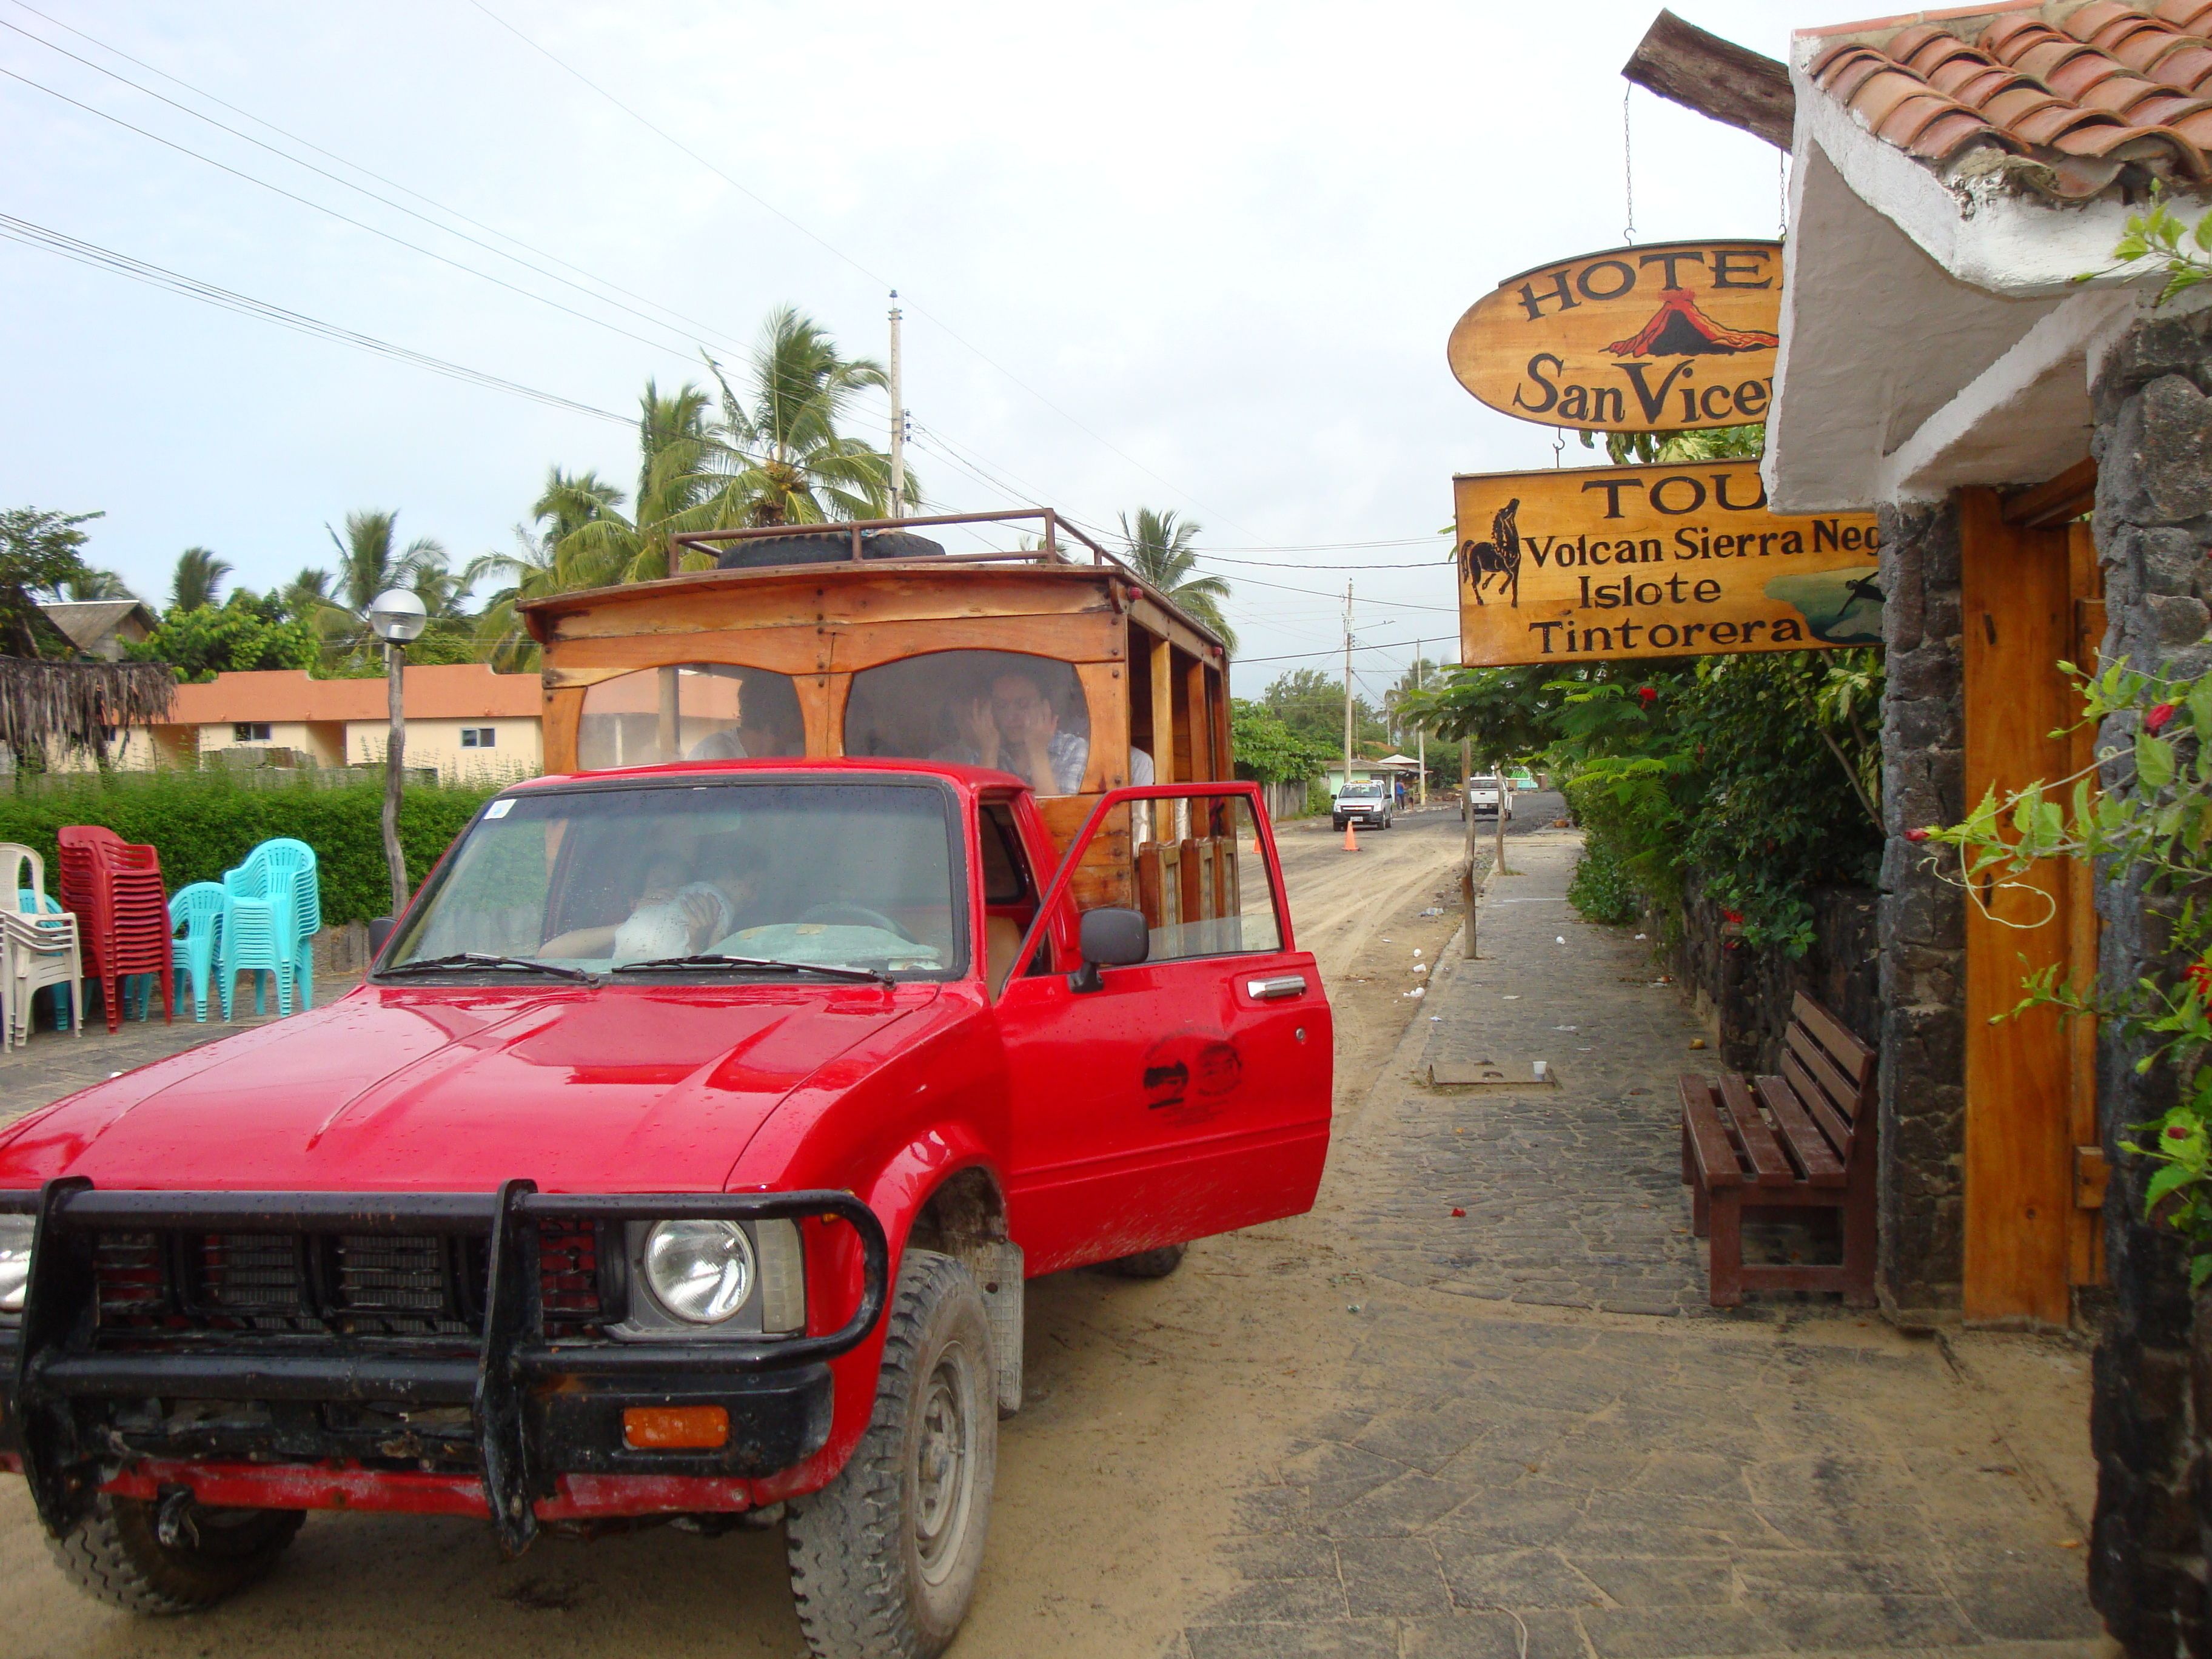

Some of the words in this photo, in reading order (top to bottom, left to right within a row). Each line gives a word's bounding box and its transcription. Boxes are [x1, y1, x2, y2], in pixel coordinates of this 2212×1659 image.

[1518, 250, 1783, 322] HOTE
[1512, 353, 1625, 423] San
[1610, 358, 1773, 424] Vice
[1521, 534, 1664, 568] Volcan
[1674, 527, 1803, 560] Sierra
[1812, 519, 1879, 556] Neg
[1577, 572, 1721, 609] Islote
[1529, 617, 1803, 654] Tintorera
